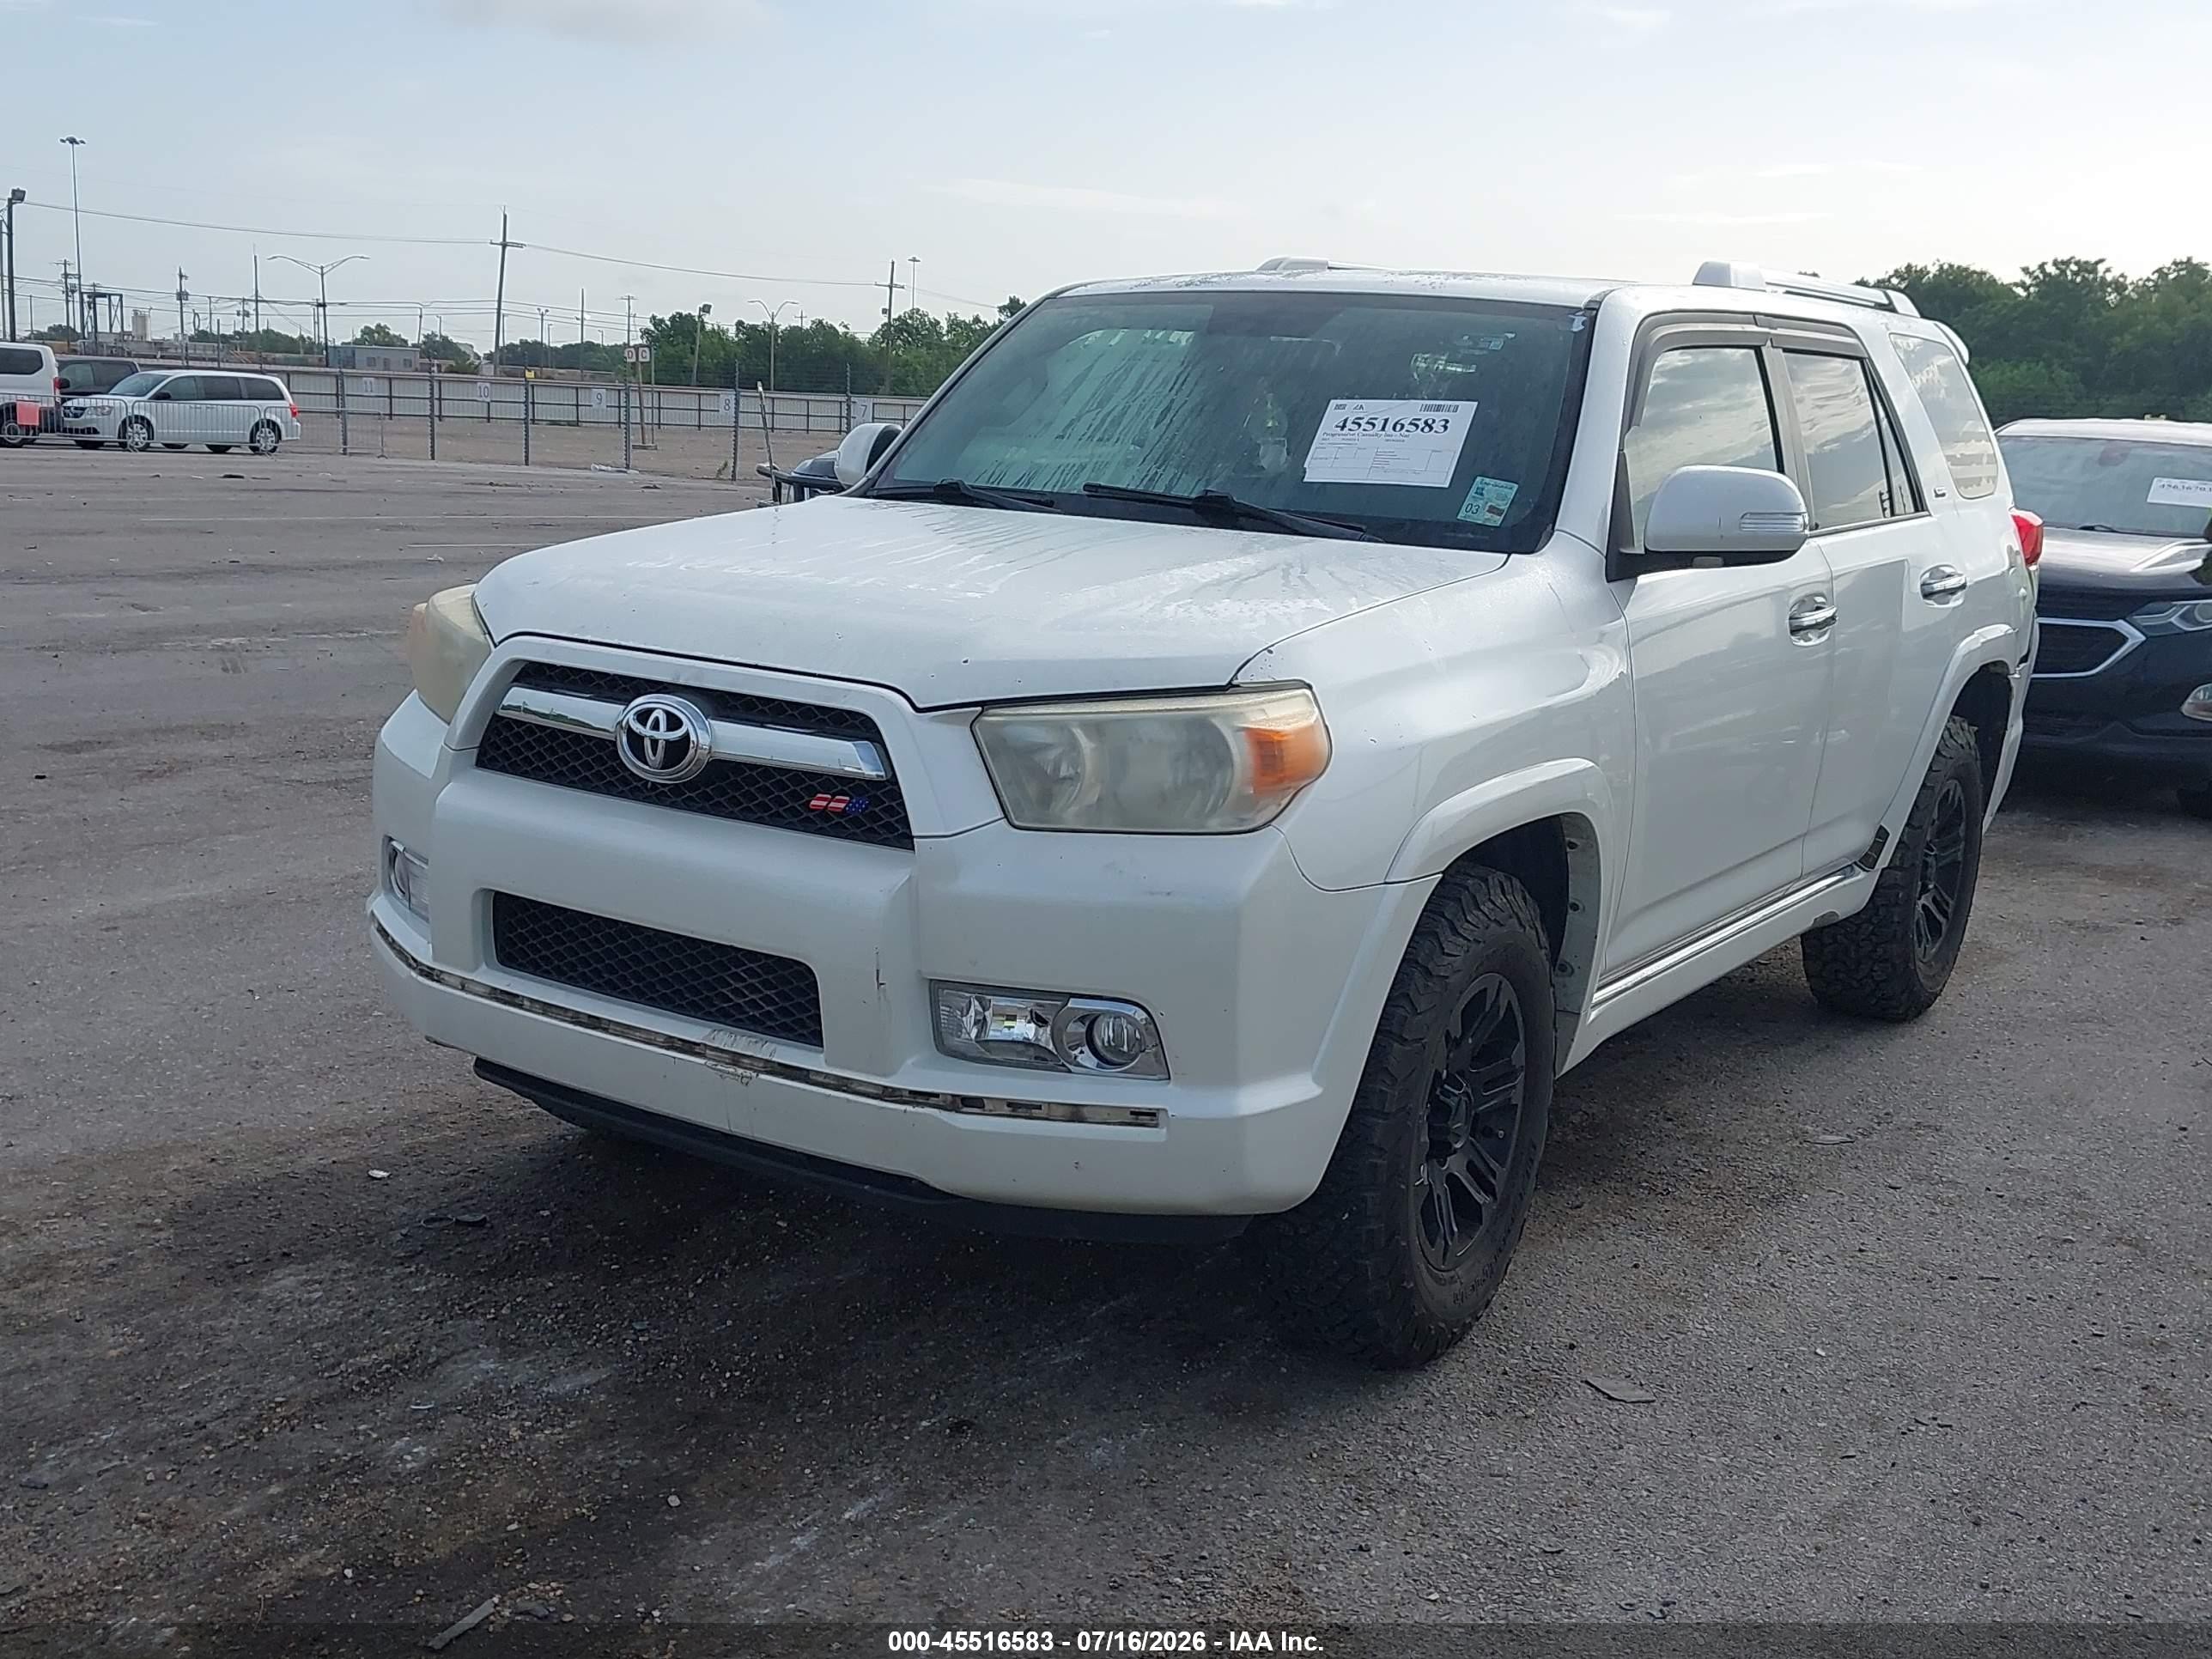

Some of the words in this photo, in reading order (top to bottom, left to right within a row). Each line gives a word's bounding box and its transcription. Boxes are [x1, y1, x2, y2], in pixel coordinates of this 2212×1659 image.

[363, 380, 374, 392] 11
[478, 385, 489, 398] 10
[596, 392, 603, 404] 9
[723, 398, 731, 410] 8
[860, 405, 867, 417] 7
[1334, 416, 1450, 434] 45516583
[1465, 502, 1480, 514] 03
